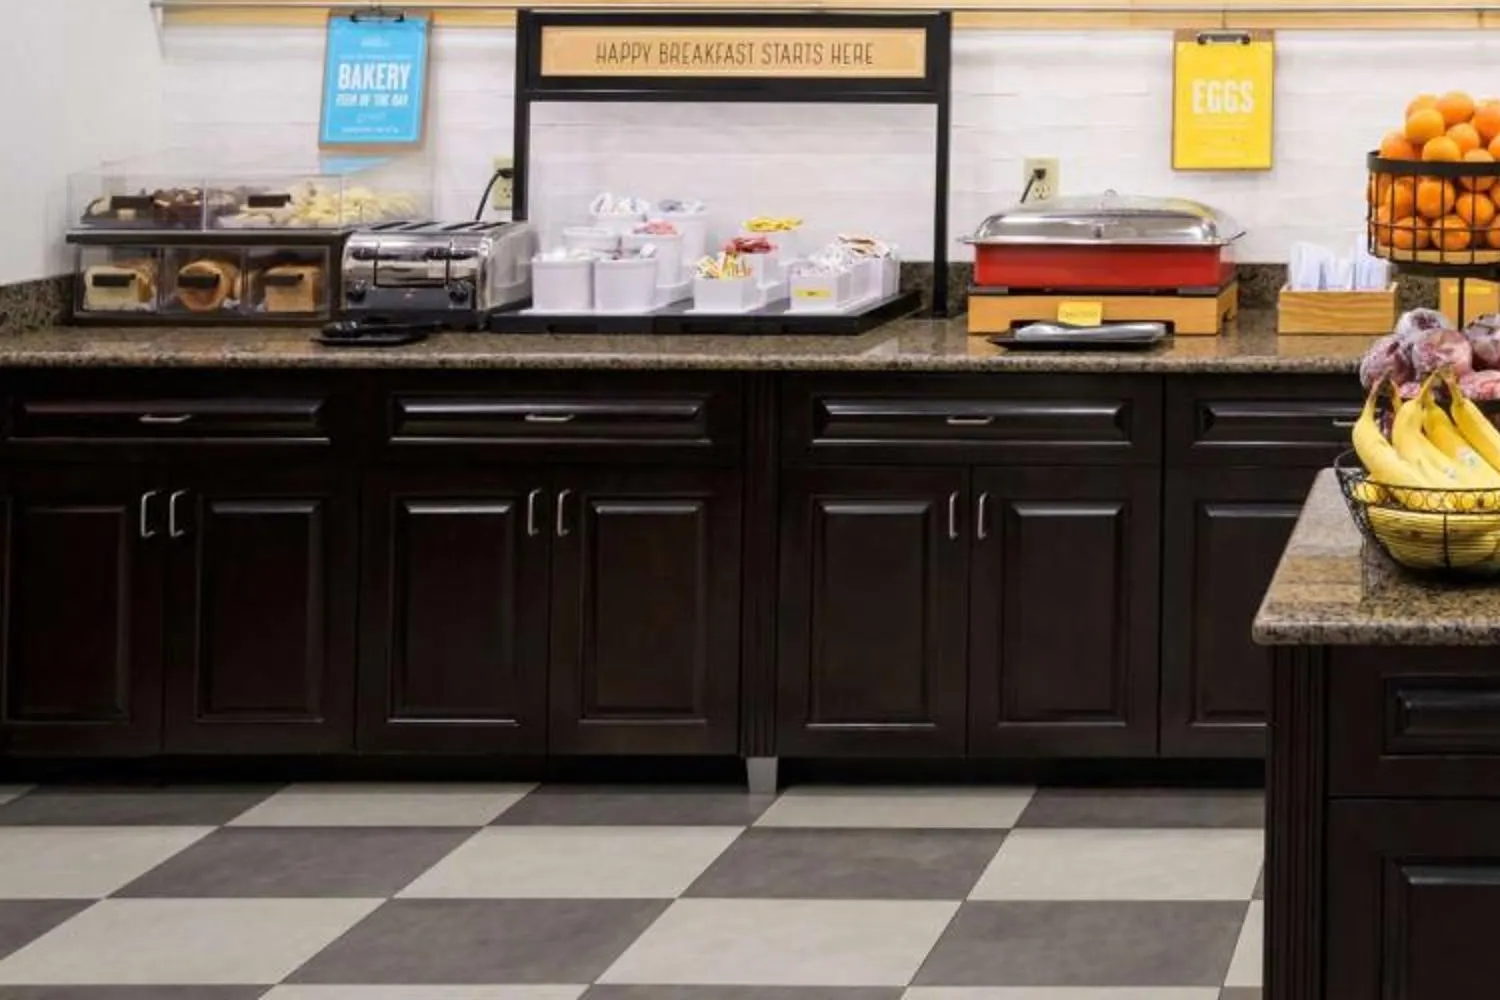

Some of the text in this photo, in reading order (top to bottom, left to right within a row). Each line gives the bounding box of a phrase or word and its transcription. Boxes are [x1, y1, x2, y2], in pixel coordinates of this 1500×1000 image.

[595, 42, 874, 66] HAPPY BREAKFAST STARTS HERE
[337, 62, 412, 91] BAKERY
[1191, 79, 1255, 115] EGGS
